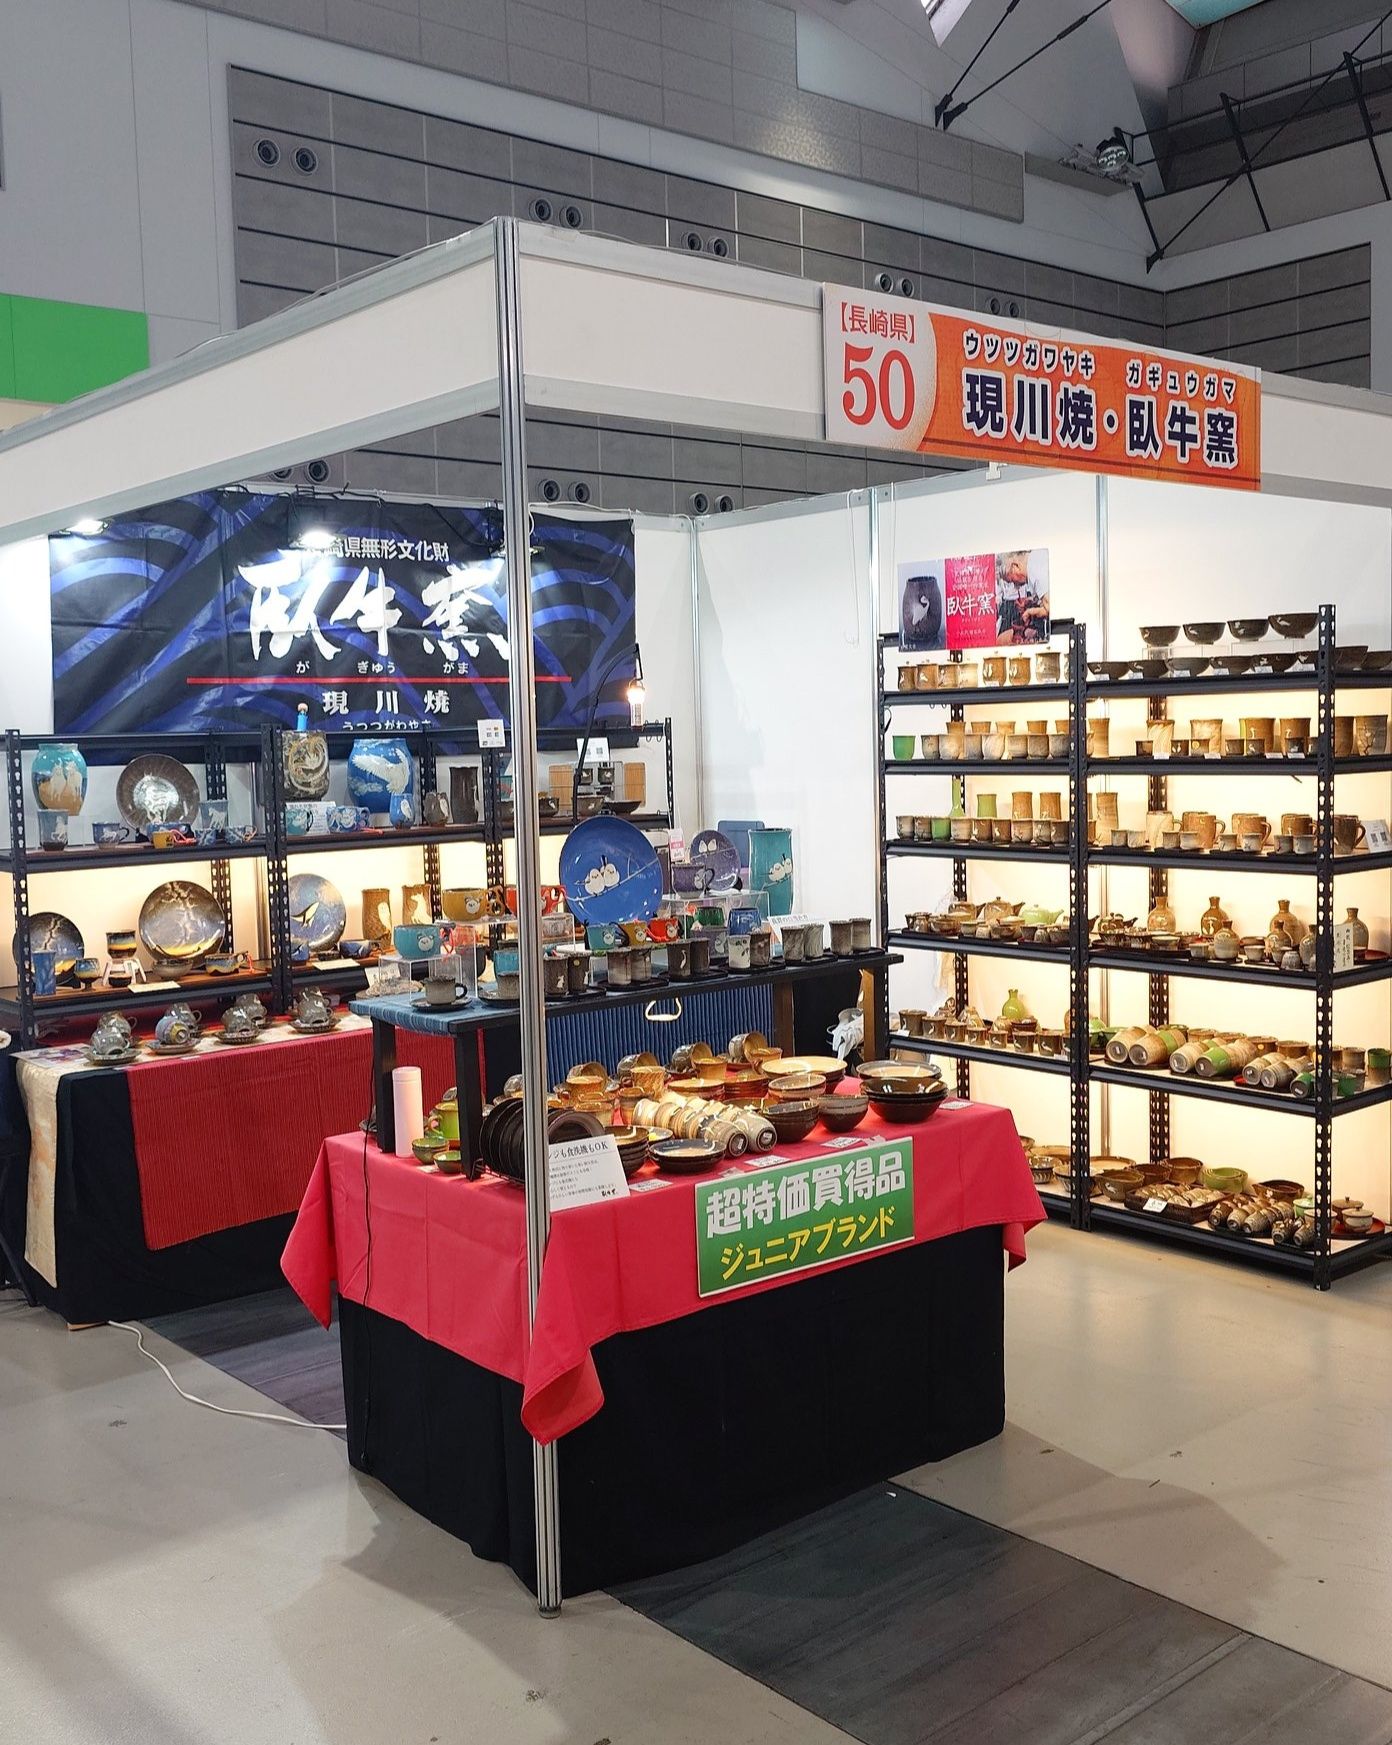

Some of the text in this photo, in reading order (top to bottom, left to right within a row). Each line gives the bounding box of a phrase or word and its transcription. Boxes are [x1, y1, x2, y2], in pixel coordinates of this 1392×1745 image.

[842, 341, 915, 431] 50
[963, 330, 1236, 401] ウツツガワヤキ ガギュウガマ
[964, 371, 1238, 466] 現川焼・臥牛窯
[308, 537, 450, 563] 崎県無形文化財
[946, 591, 995, 616] 臥牛窯
[296, 660, 469, 674] が ぎゅう がま
[705, 1150, 907, 1239] 超特価買得品
[719, 1205, 897, 1281] ジュニアブランド
